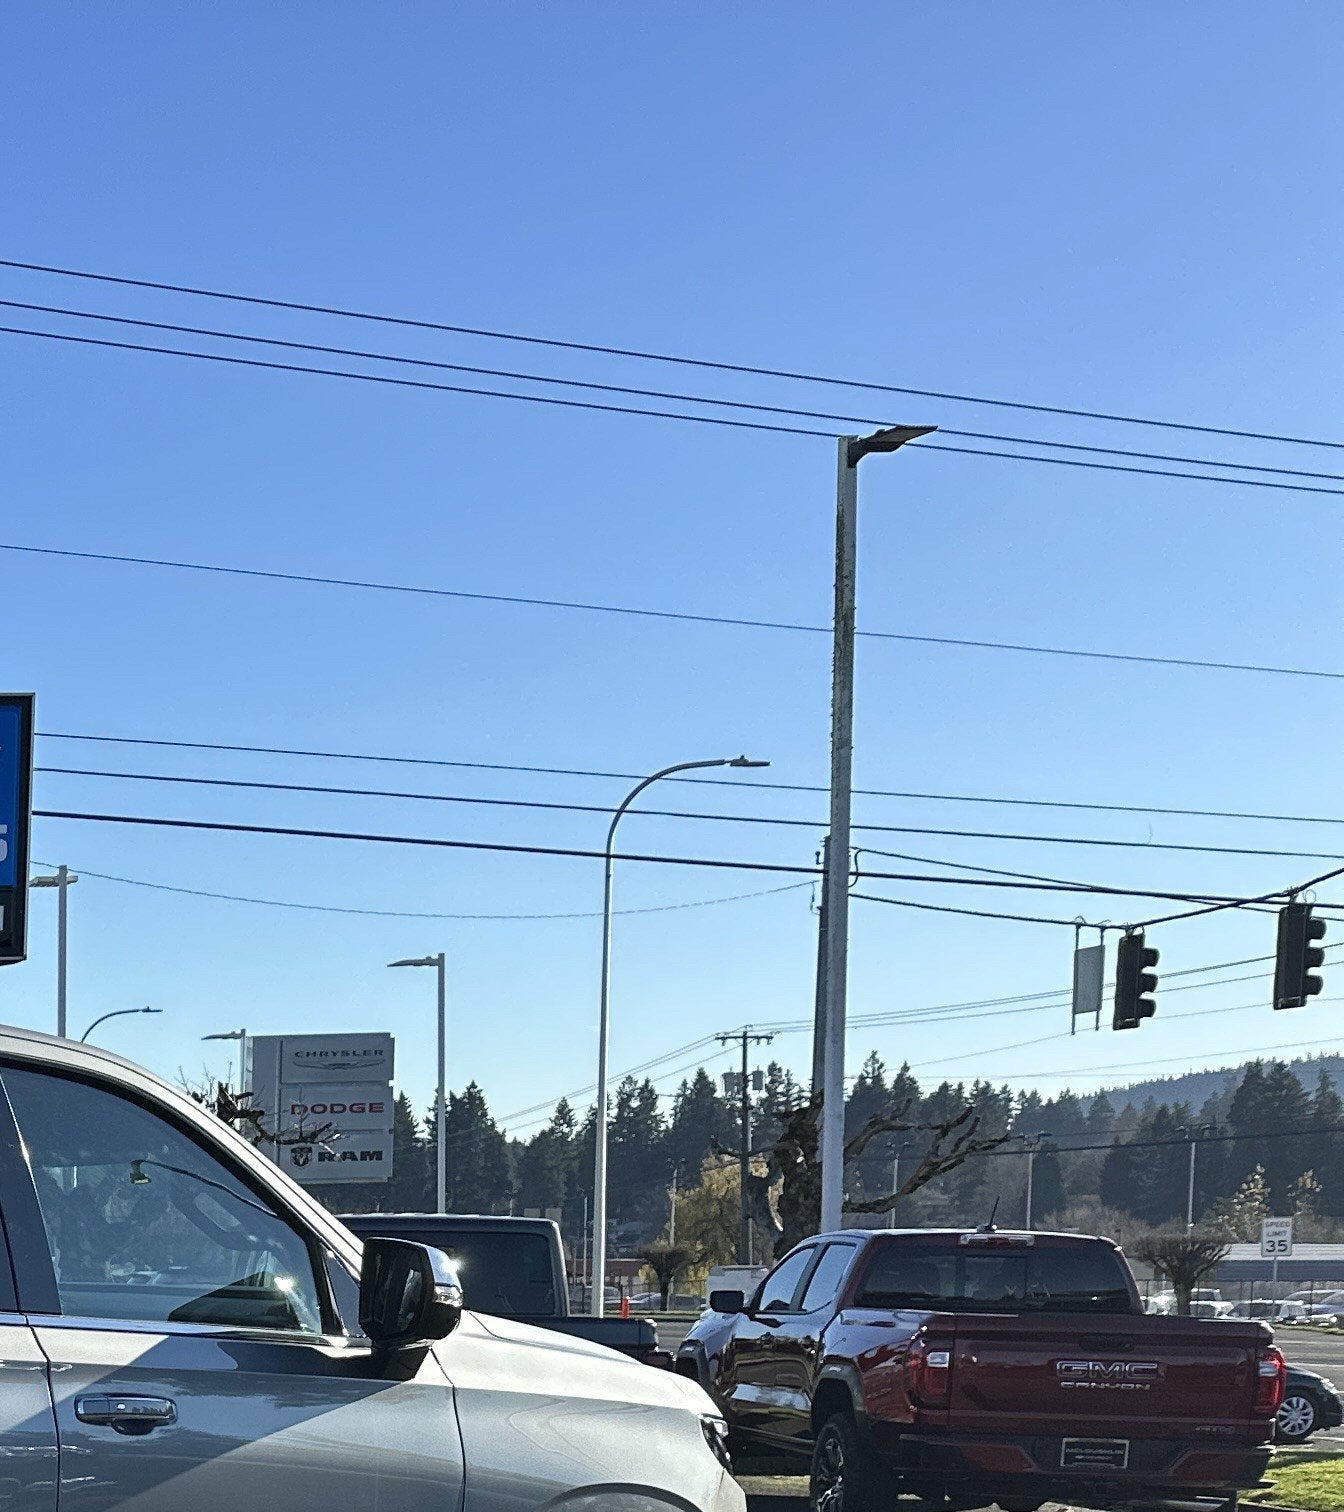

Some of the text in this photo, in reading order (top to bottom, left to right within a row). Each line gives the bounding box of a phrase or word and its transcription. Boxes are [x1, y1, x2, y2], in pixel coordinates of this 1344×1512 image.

[294, 1049, 384, 1058] CHRYSLER
[290, 1102, 385, 1115] DODGE
[317, 1150, 383, 1162] RAM
[1265, 1239, 1288, 1253] 35
[1056, 1360, 1158, 1380] GMC
[1060, 1381, 1152, 1391] CANYON
